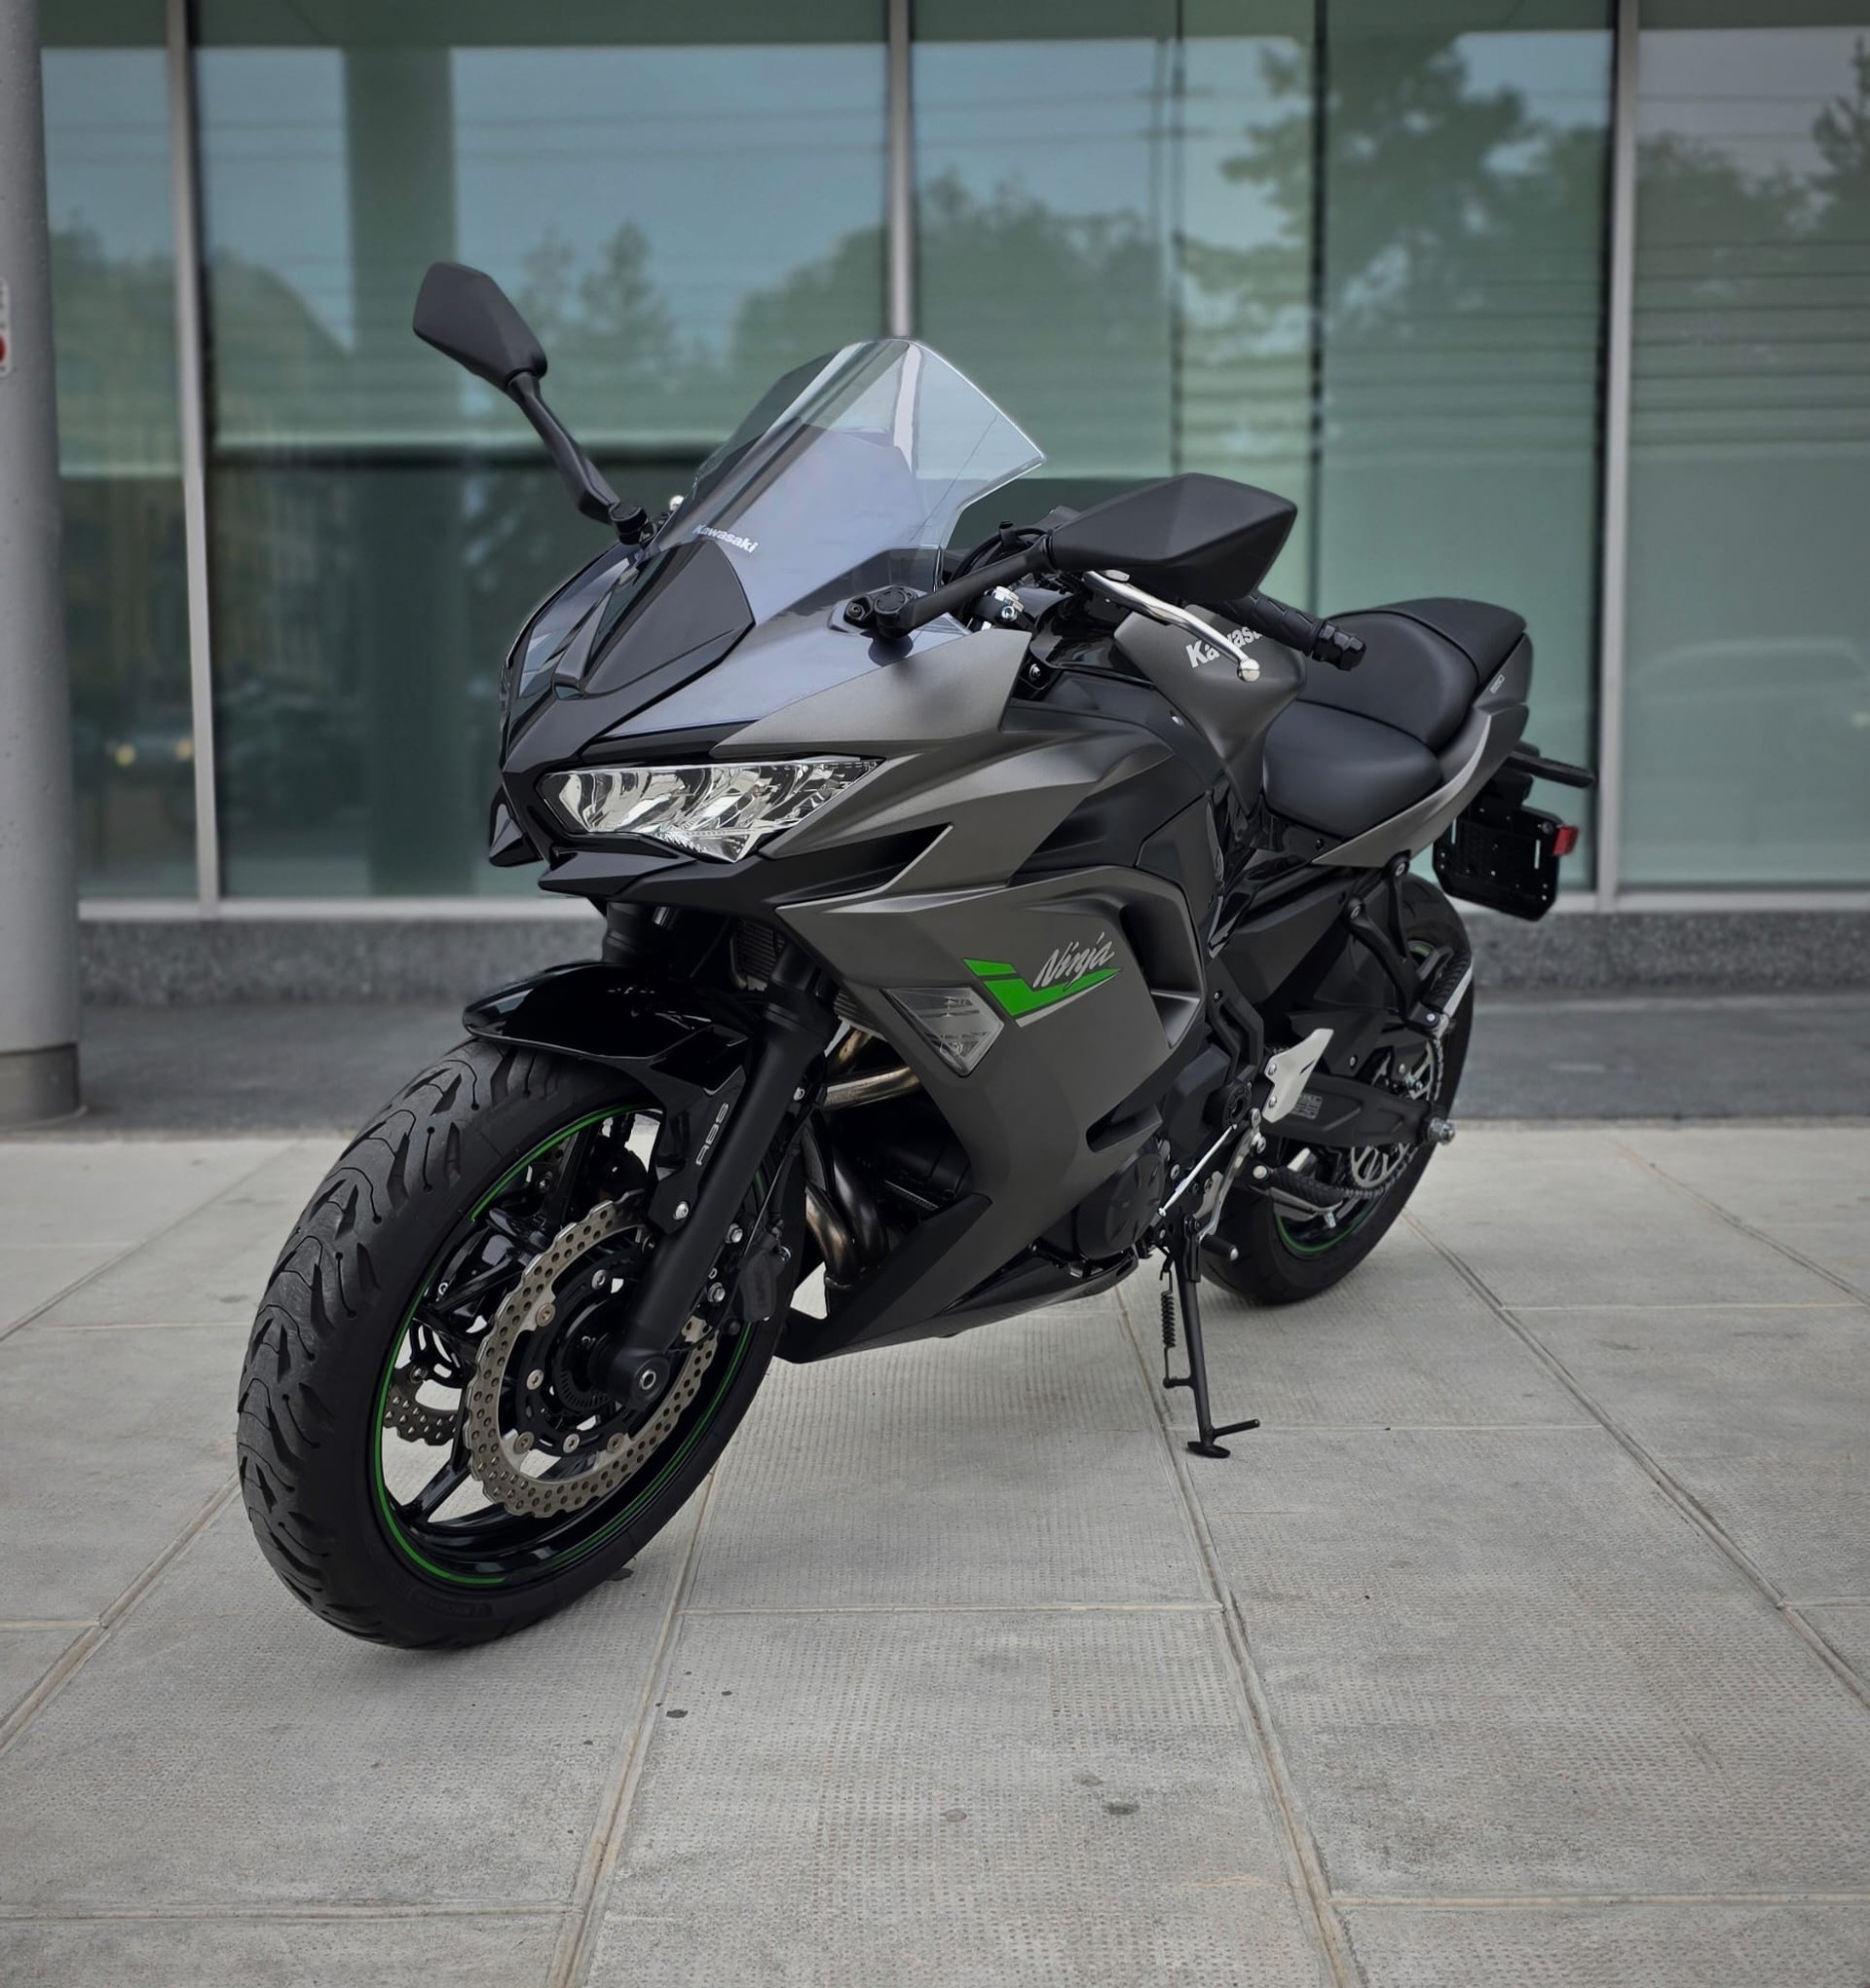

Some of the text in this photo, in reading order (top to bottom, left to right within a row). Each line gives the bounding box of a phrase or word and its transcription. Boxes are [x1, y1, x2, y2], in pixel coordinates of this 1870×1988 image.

[692, 524, 759, 553] Kawasaki
[1032, 931, 1115, 992] Ninja
[695, 1102, 729, 1166] ABS
